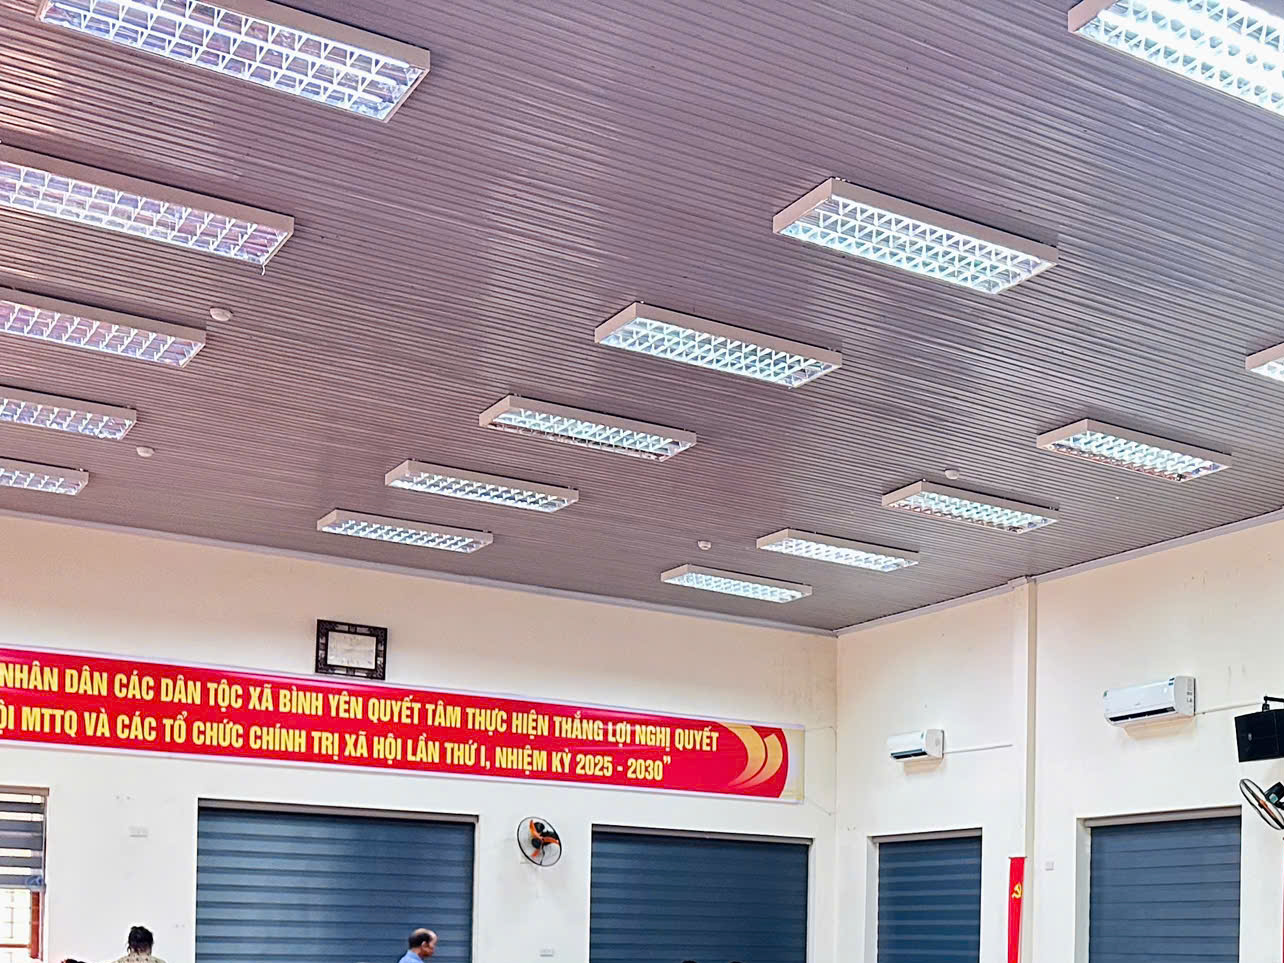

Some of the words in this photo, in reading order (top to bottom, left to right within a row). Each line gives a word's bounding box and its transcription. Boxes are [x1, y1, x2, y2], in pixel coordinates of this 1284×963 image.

[22, 707, 77, 737] MTTQ
[84, 708, 110, 737] VÀ
[117, 712, 156, 740] CÁC
[163, 711, 187, 743] TỔ
[192, 719, 243, 748] CHỨC
[249, 724, 306, 753] CHÍNH
[311, 731, 339, 760] TRỊ
[344, 731, 368, 757] XÃ
[373, 737, 401, 765] HỘI
[407, 732, 439, 763] LẦN
[445, 740, 476, 766] THỨ
[480, 746, 490, 770] I,
[495, 745, 547, 775] NHIỆM
[551, 748, 572, 773] KỲ
[576, 757, 612, 777] 2025
[65, 666, 107, 696] DÂN
[114, 671, 154, 700] CÁC
[161, 675, 200, 704] DÂN
[207, 679, 242, 712] TỘC
[249, 684, 273, 711] XÃ
[279, 686, 323, 715] BÌNH
[329, 690, 362, 719] YÊN
[368, 696, 421, 724] QUYẾT
[426, 700, 461, 728] TÂM
[466, 708, 507, 735] THỰC
[512, 710, 548, 739] HIỆN
[553, 711, 603, 742] THẮNG
[608, 723, 631, 747] LỢI
[635, 725, 670, 749] NGHỊ
[675, 725, 719, 752] QUYẾT
